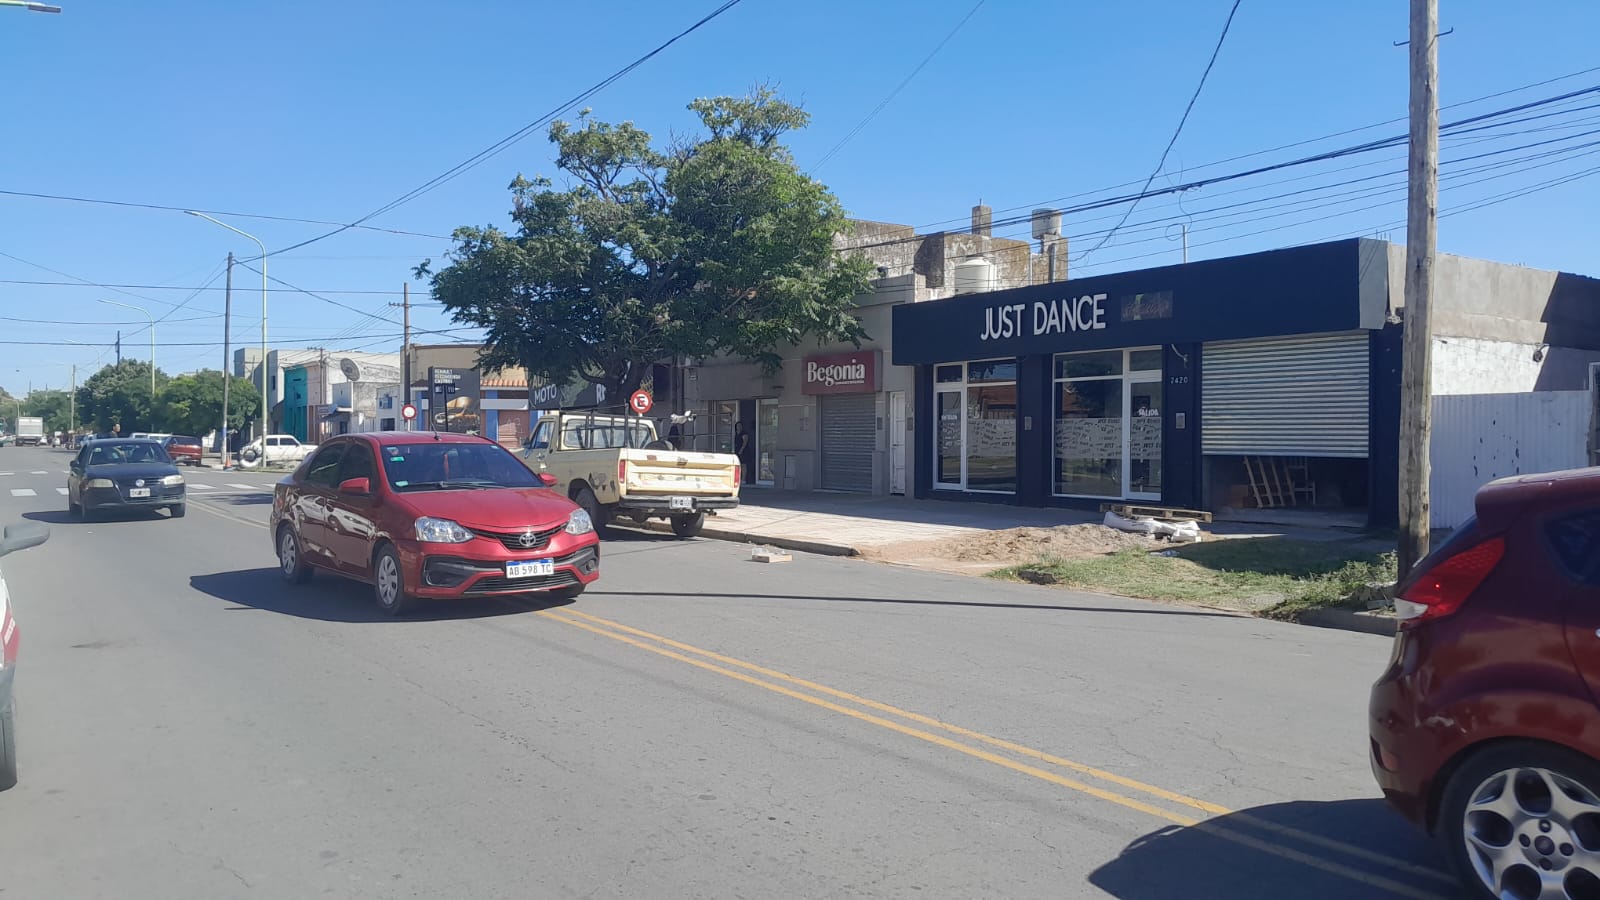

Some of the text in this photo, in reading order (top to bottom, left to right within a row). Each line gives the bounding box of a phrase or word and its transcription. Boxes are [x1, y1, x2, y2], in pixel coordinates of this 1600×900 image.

[980, 304, 1025, 340] JUST
[1033, 293, 1107, 336] DANCE
[807, 358, 865, 387] Begonia
[534, 384, 557, 405] MOTO
[522, 564, 537, 575] 598
